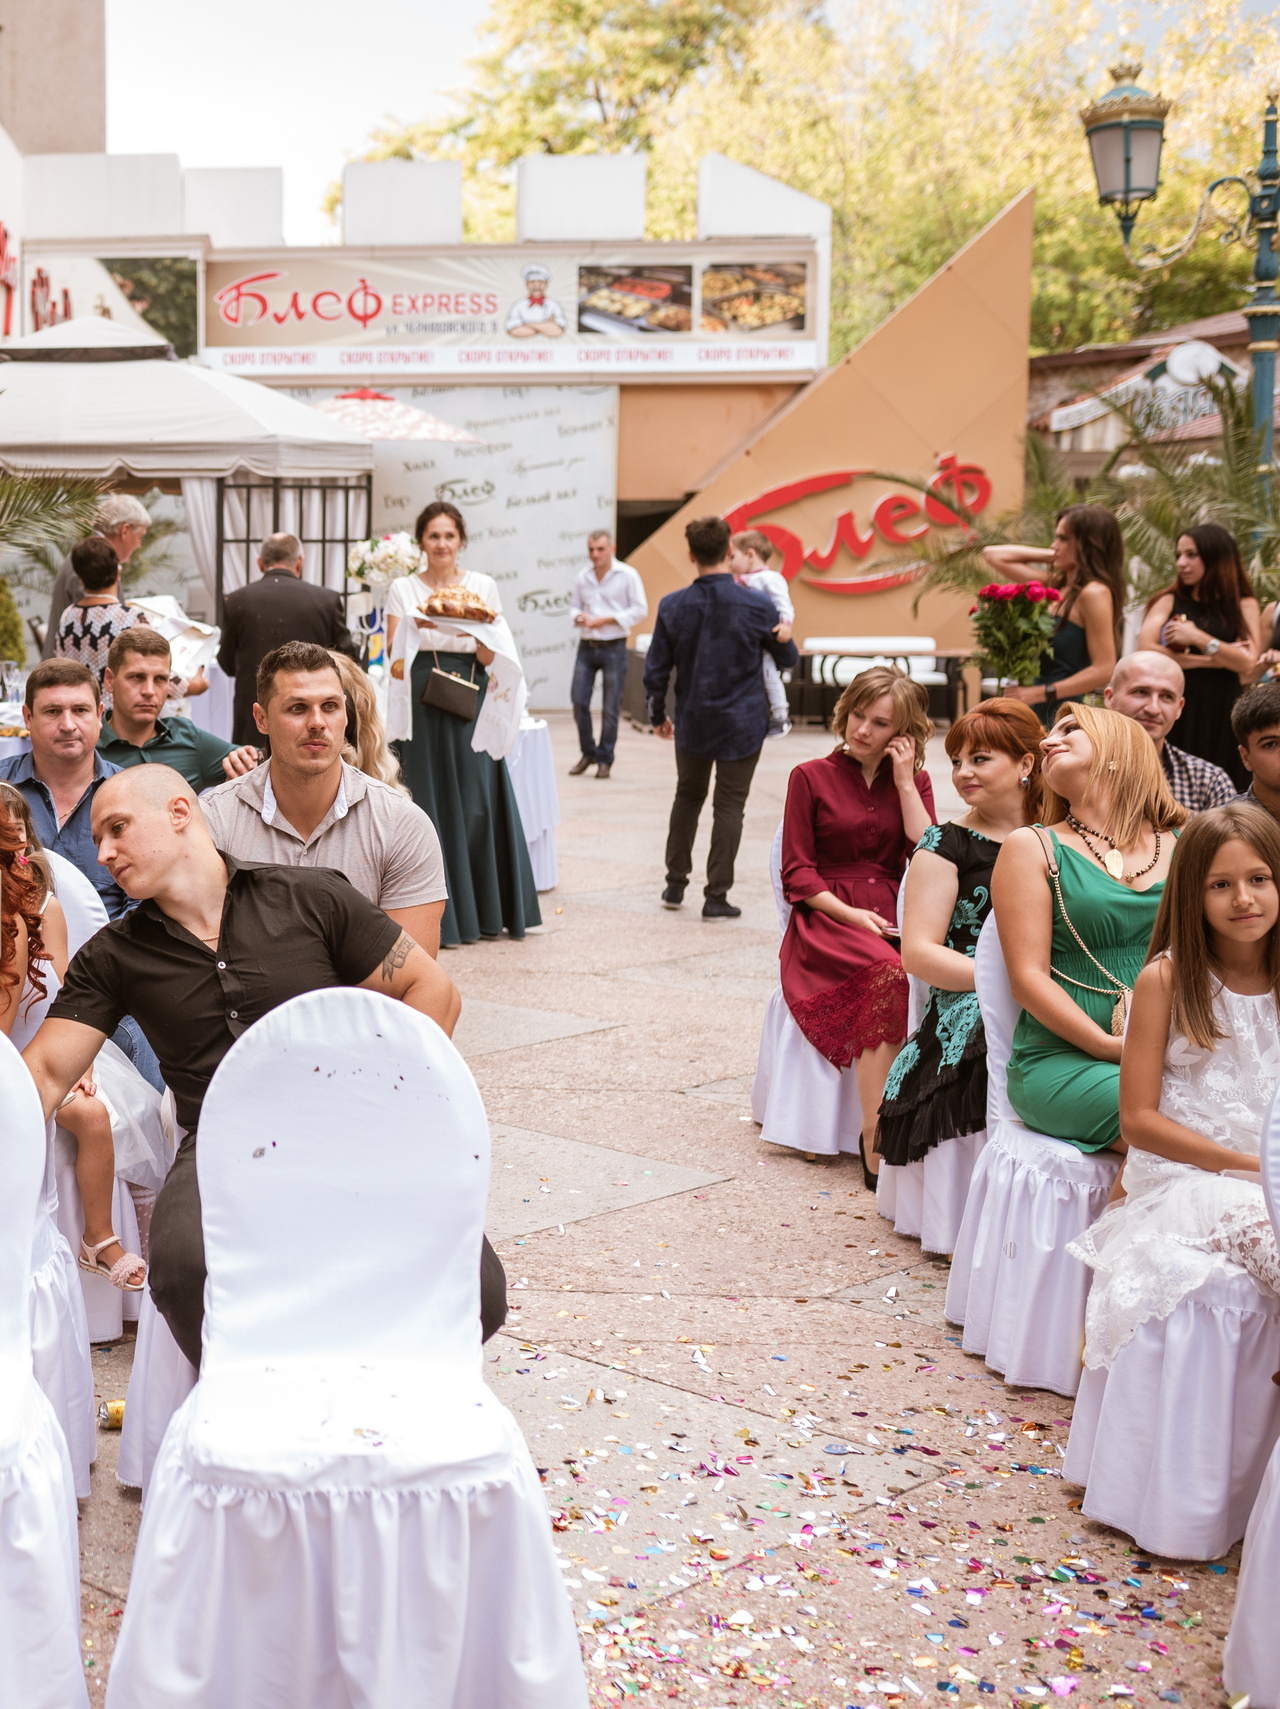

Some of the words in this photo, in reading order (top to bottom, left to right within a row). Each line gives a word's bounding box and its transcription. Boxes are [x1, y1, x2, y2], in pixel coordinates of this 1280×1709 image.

[216, 271, 382, 328] Блеф
[391, 293, 498, 315] EXPRESS
[222, 352, 255, 366] СКОРО
[340, 351, 373, 365] СКОРО
[458, 349, 491, 364] СКОРО
[577, 348, 611, 363] СКОРО
[697, 347, 731, 362] СКОРО
[434, 478, 496, 504] Блеф
[721, 452, 992, 588] Блеф
